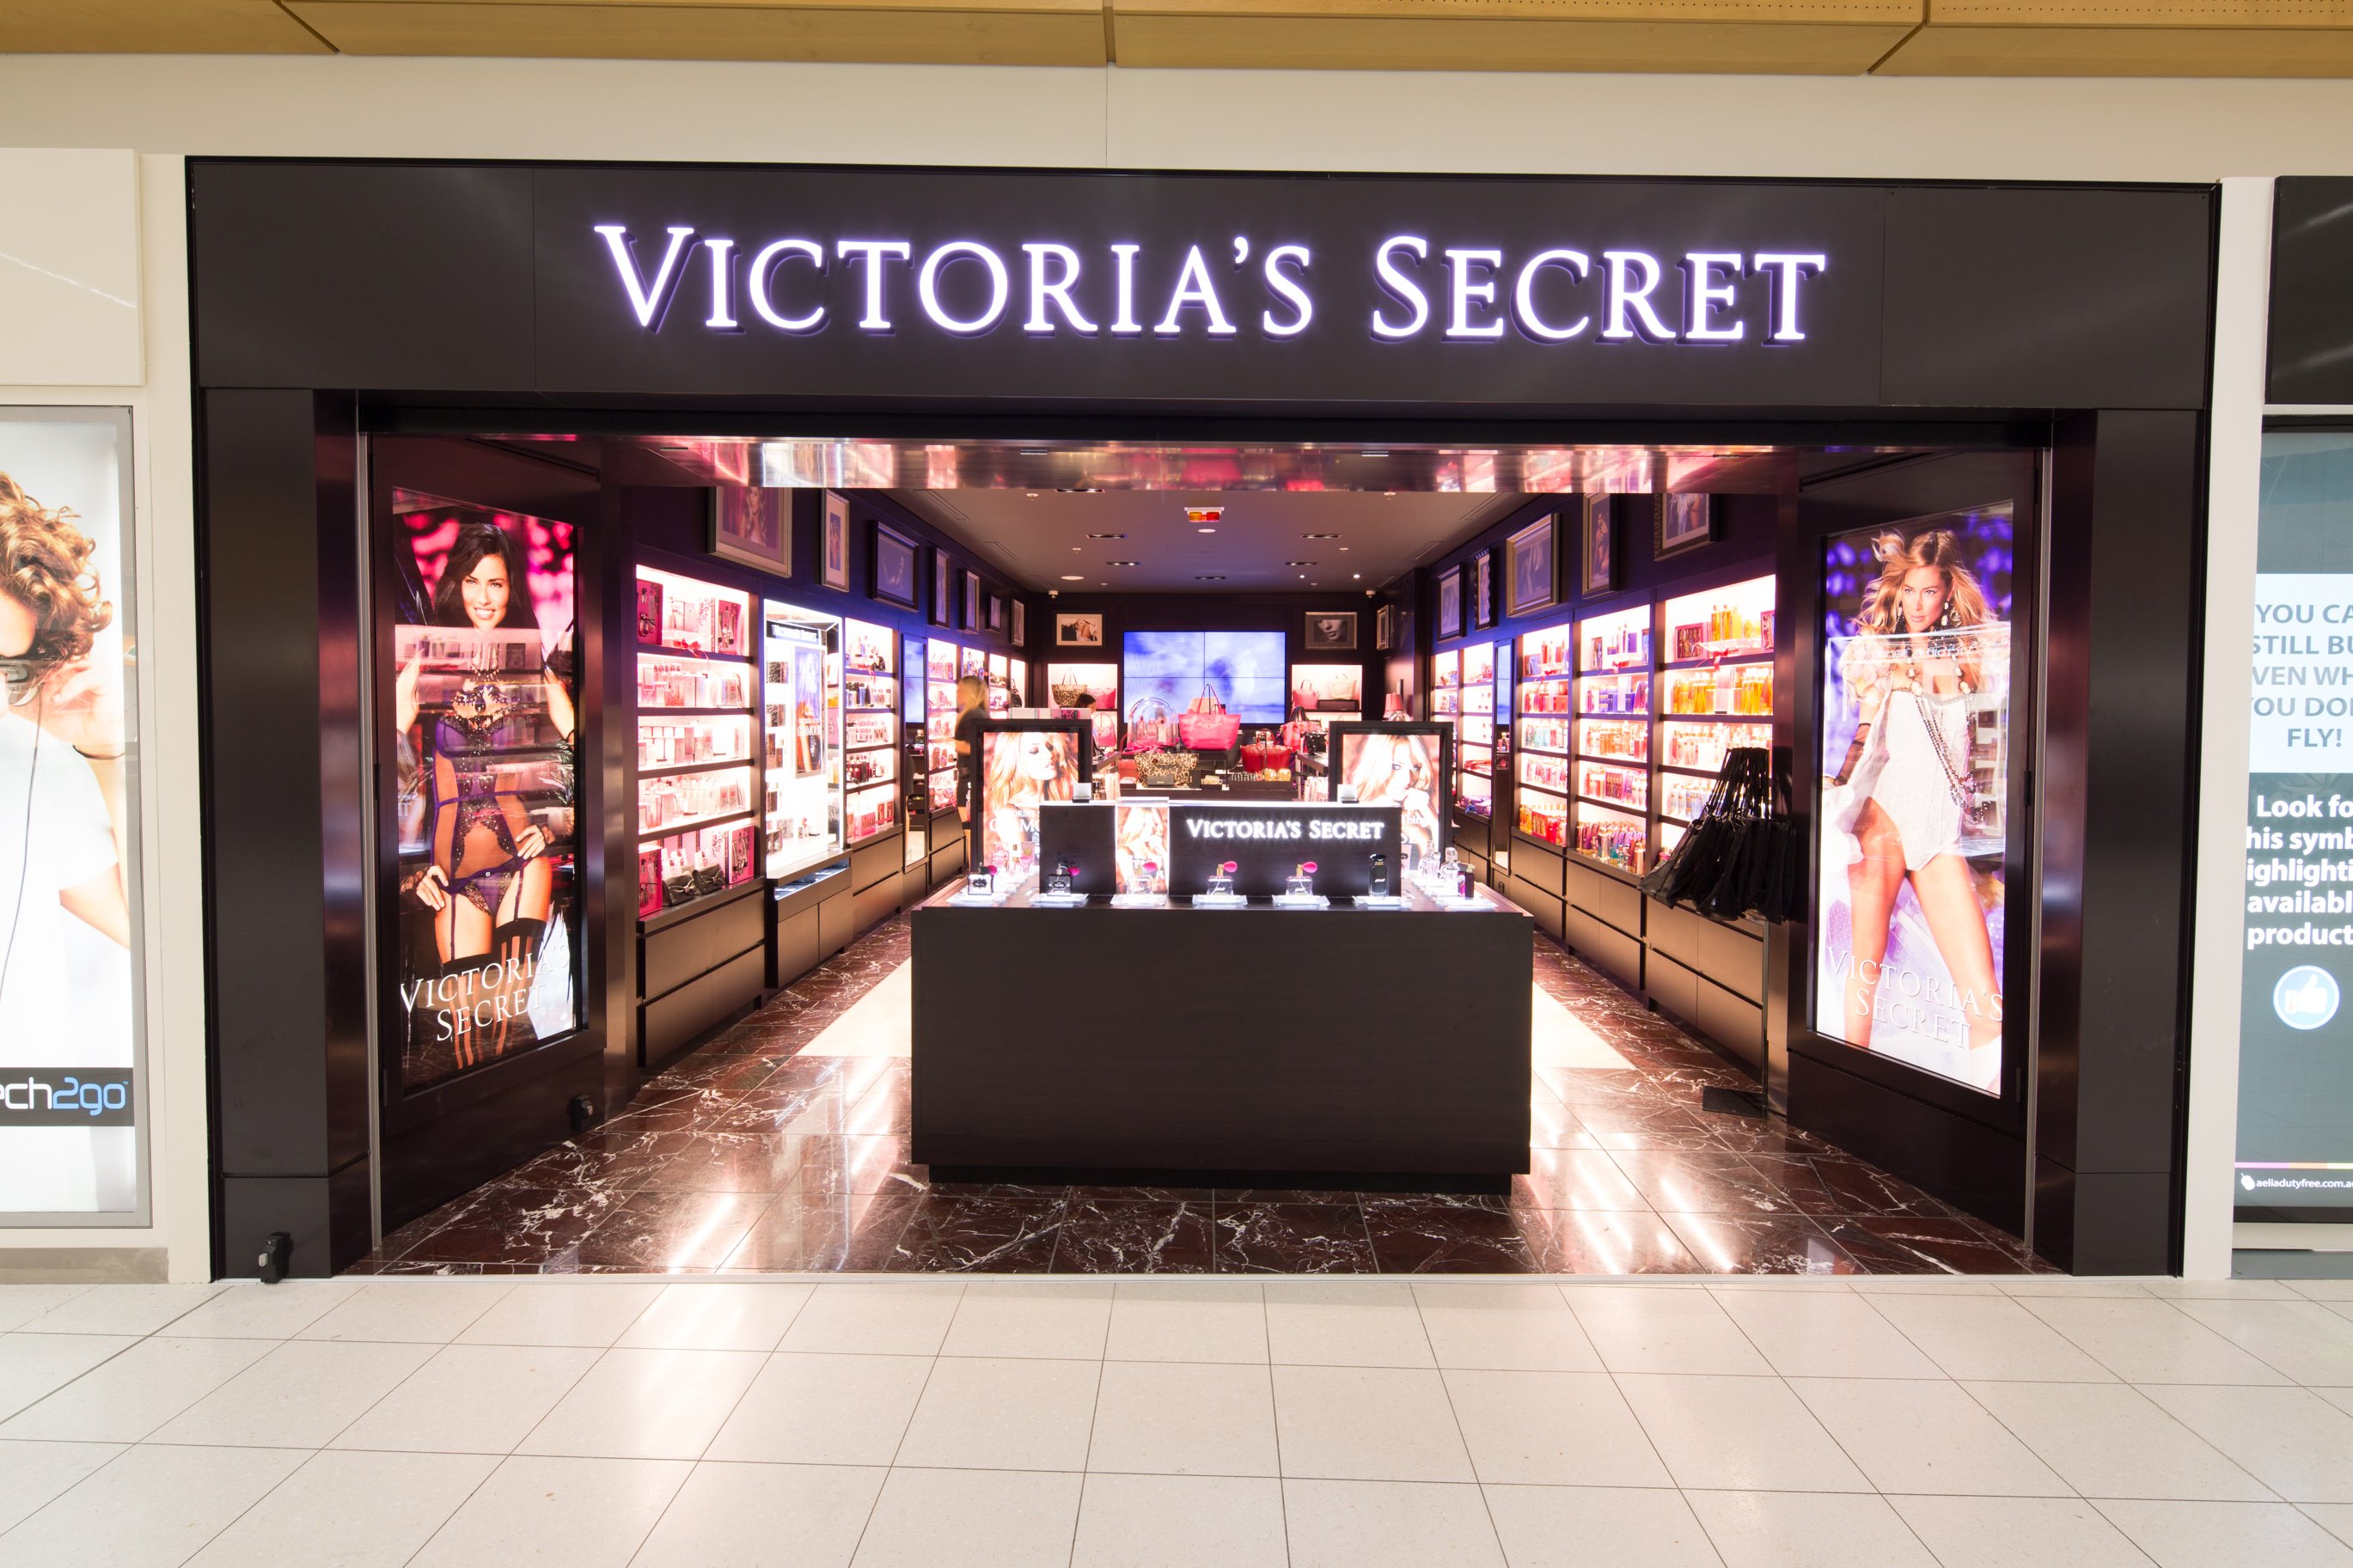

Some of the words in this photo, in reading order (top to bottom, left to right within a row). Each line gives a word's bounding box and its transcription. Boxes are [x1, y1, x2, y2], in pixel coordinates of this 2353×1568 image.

[594, 226, 1313, 335] VICTORIA'S
[1372, 235, 1826, 340] SECRET
[2255, 603, 2314, 624] YOU
[2252, 696, 2296, 717] OU
[2304, 696, 2353, 717] DO
[2287, 728, 2342, 747] FLY!
[2257, 794, 2324, 818] Look
[1186, 819, 1302, 839] VICTORIA'S
[1309, 820, 1385, 839] SECRET
[400, 943, 569, 1013] VICTORIA'S
[1826, 946, 2003, 1022] VICTORIA'S
[437, 985, 546, 1041] SECRET
[1855, 988, 1971, 1049] SECRET
